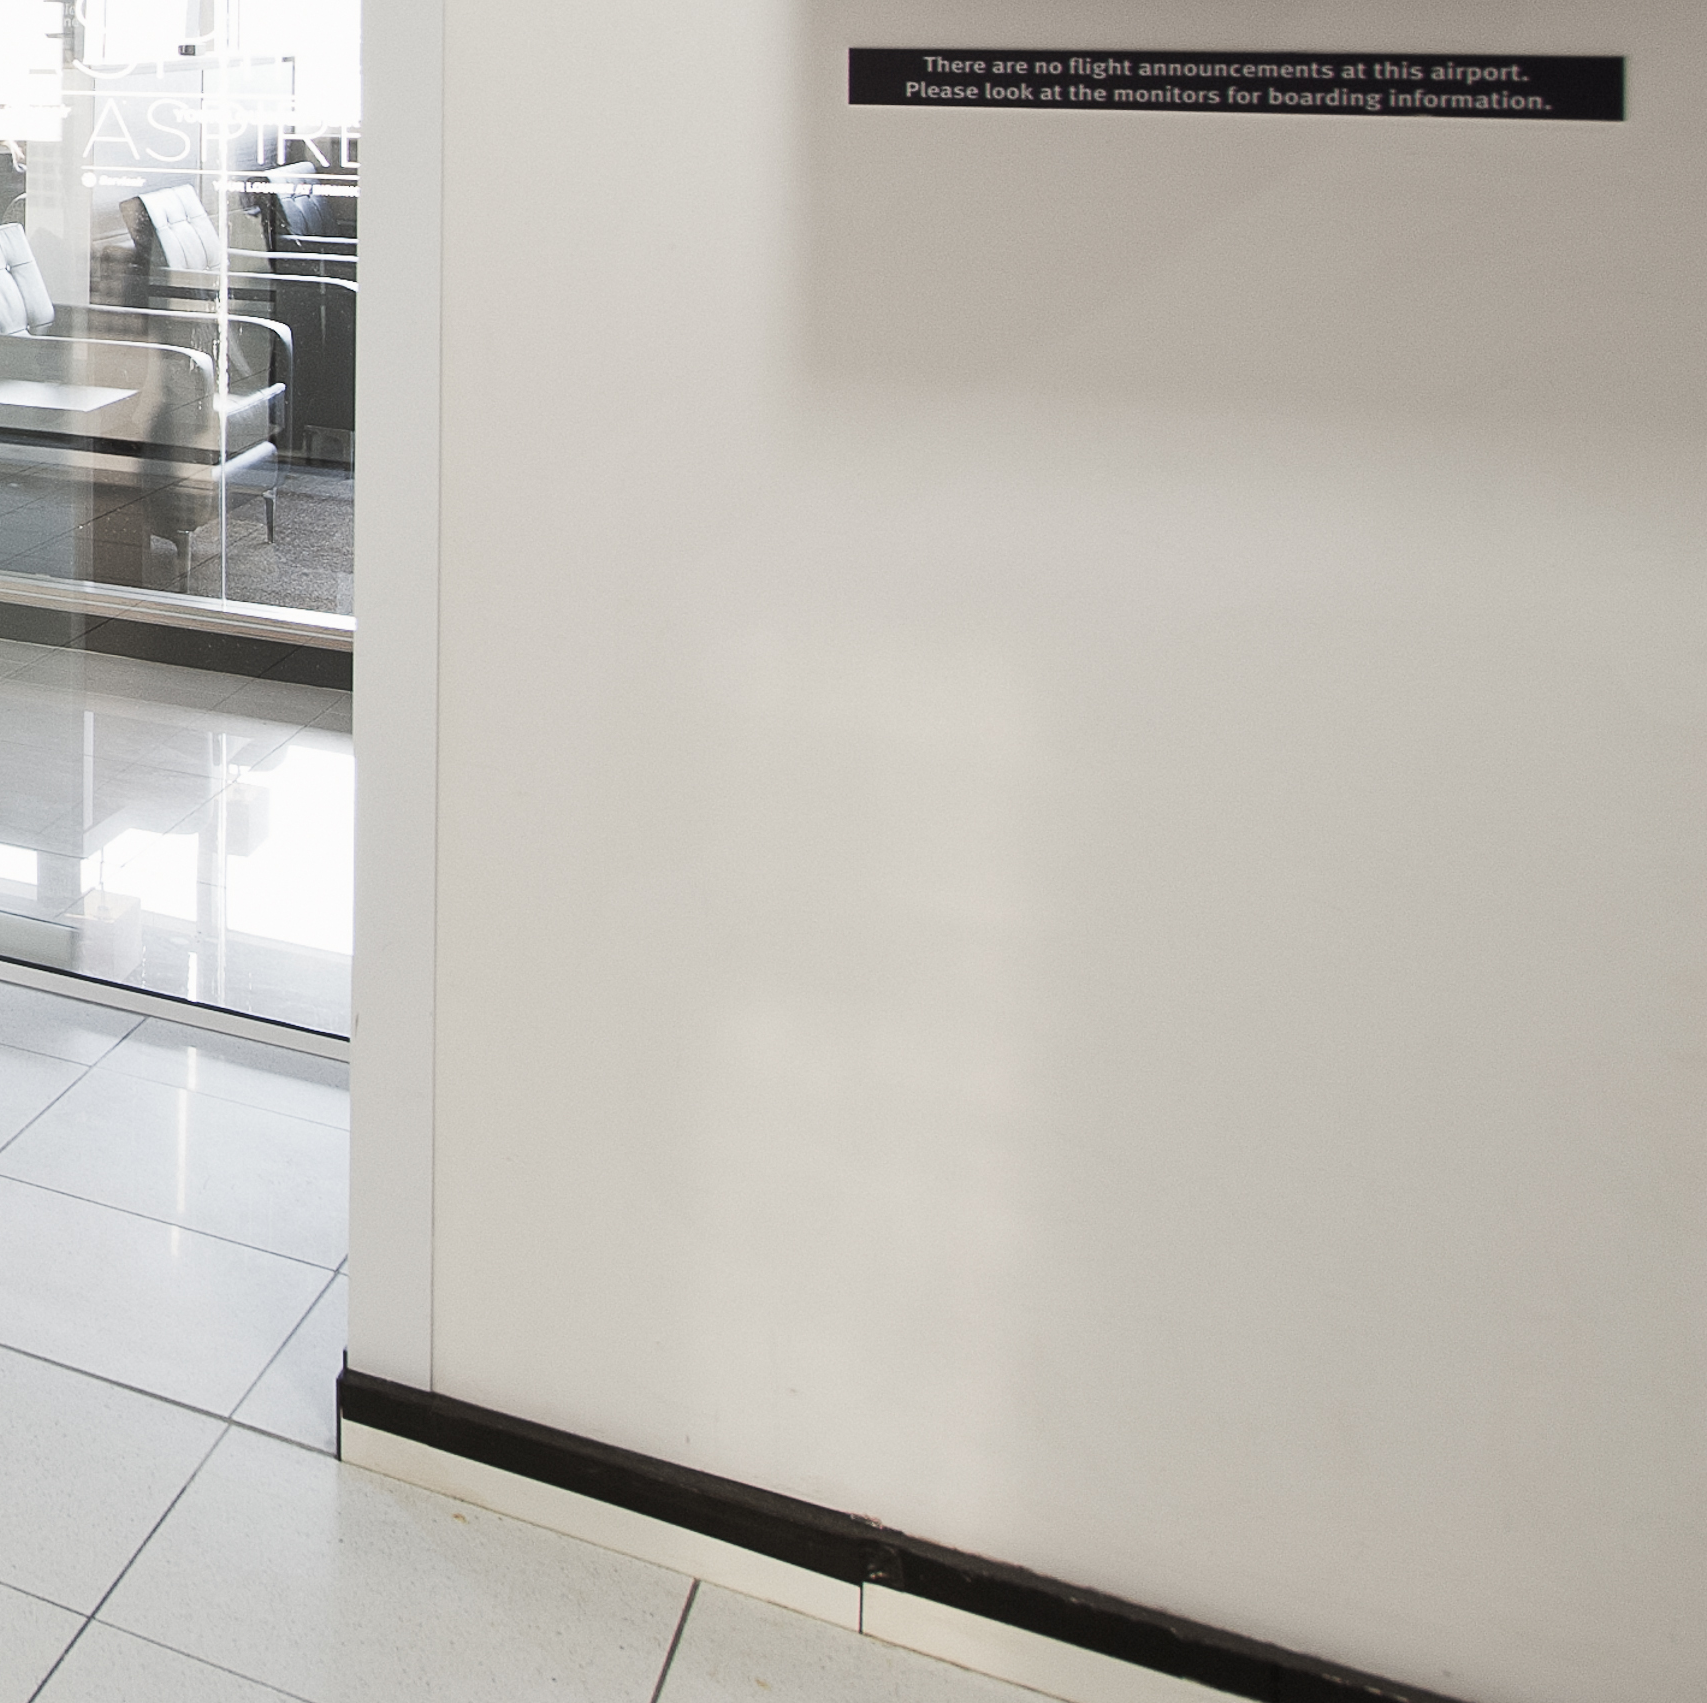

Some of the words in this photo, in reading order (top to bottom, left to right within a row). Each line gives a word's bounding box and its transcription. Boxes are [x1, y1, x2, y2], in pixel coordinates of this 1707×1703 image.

[924, 57, 985, 73] There
[993, 62, 1027, 73] are
[1036, 62, 1061, 73] no
[1070, 58, 1130, 78] flight
[1139, 64, 1333, 78] announcements
[1342, 64, 1364, 78] at
[1375, 62, 1422, 78] this
[1432, 66, 1527, 83] airport.
[907, 82, 978, 98] Please
[986, 83, 1033, 99] look
[1041, 86, 1061, 100] at
[1070, 85, 1106, 101] the
[1115, 88, 1219, 103] monitors
[1229, 87, 1260, 103] for
[1270, 88, 1380, 110] boarding
[1389, 89, 1552, 110] information.
